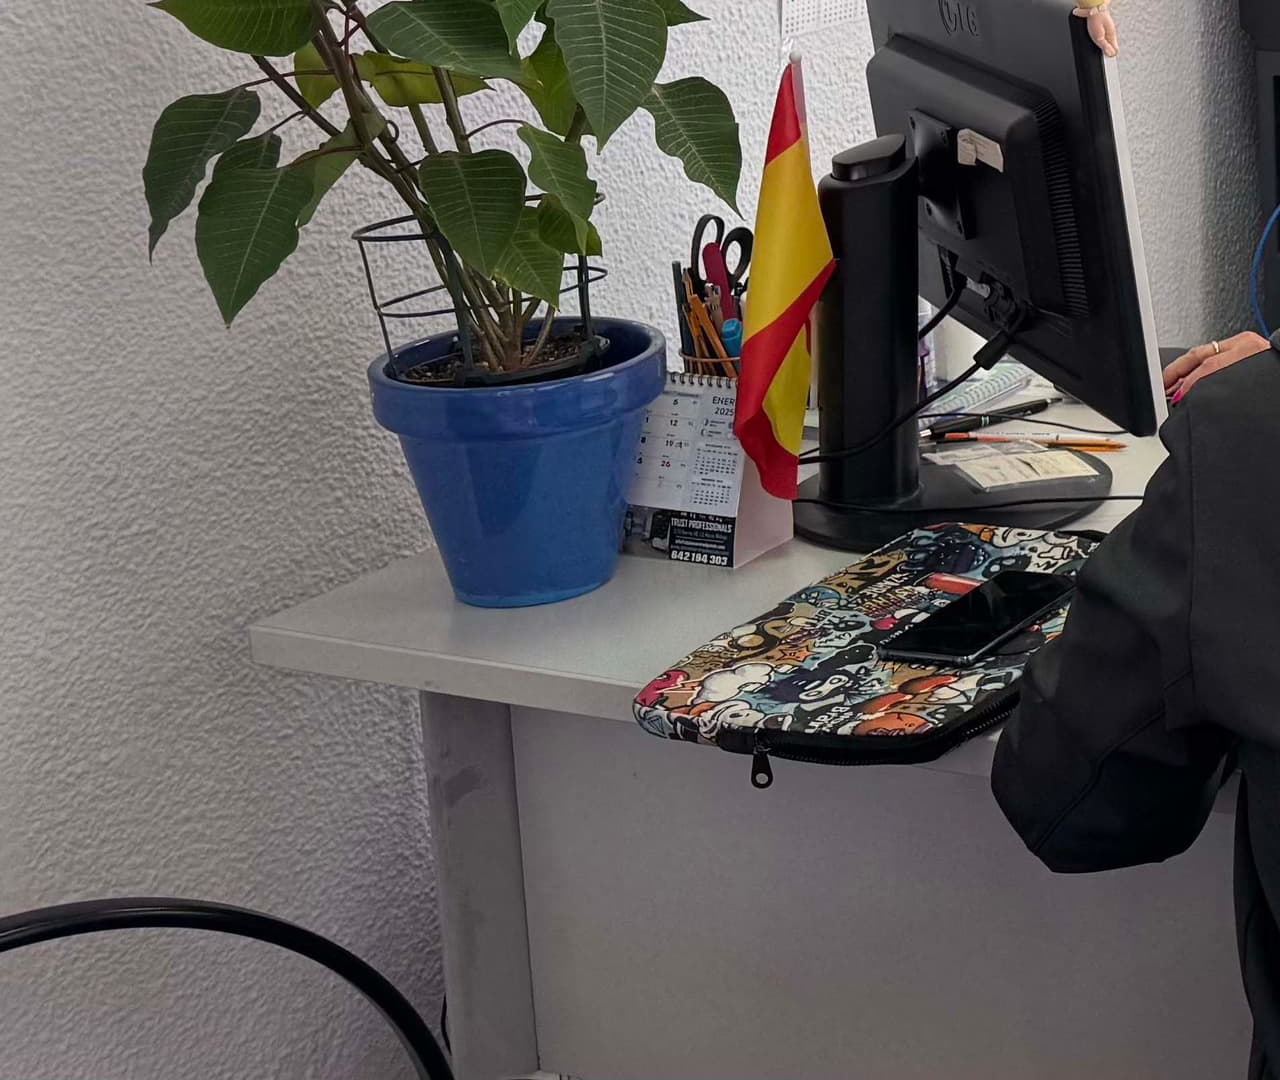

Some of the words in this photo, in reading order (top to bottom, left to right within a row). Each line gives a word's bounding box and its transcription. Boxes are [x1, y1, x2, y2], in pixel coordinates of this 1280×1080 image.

[712, 396, 735, 406] ENER
[714, 407, 734, 417] 2025
[688, 520, 732, 533] PROFESSIONALS
[671, 550, 690, 561] 642
[709, 555, 728, 566] 303
